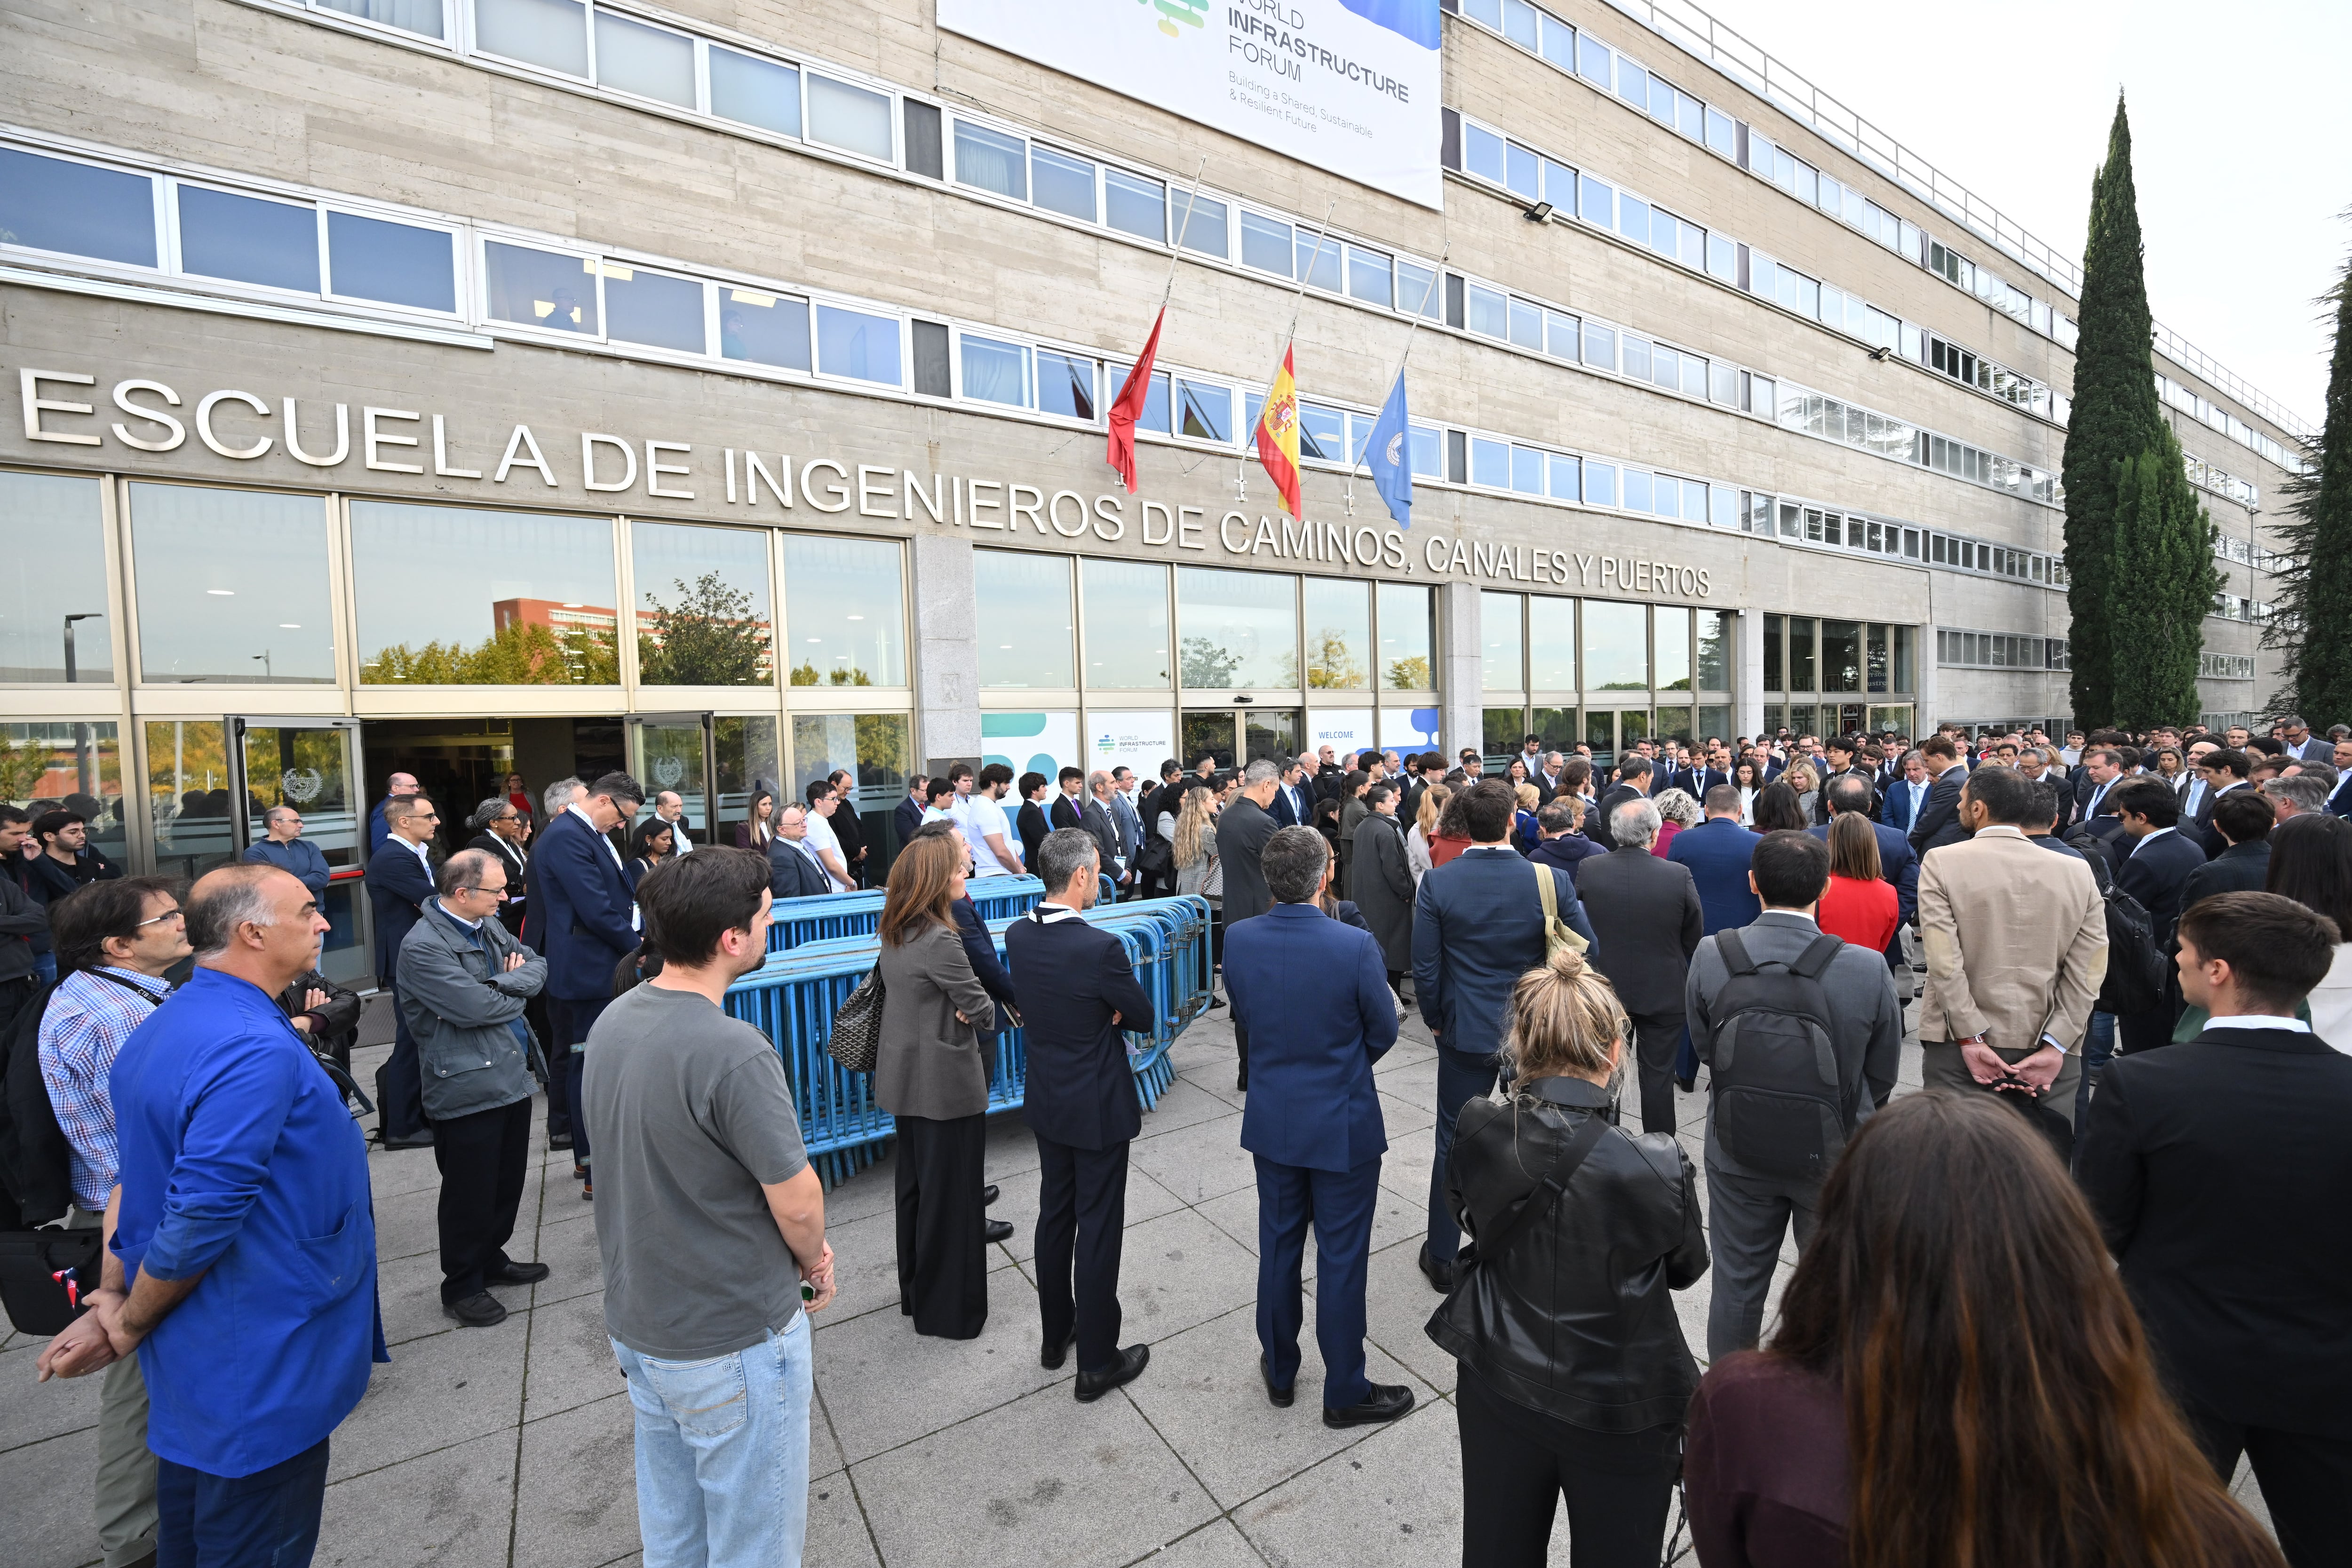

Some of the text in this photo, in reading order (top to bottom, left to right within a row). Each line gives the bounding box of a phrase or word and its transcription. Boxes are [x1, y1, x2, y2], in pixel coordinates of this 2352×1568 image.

[1239, 0, 1304, 30] ORLD
[1228, 7, 1409, 104] INFRASTRUCTURE
[1229, 34, 1301, 83] FORUM
[1229, 70, 1373, 139] Building a Shared, Sustainable
[1229, 88, 1317, 133] & Resilient Future
[19, 367, 1712, 598] ESCUELA DE INGENIEROS DE CAMINOS, CANALES Y PUERTOS
[1319, 731, 1354, 739] WELCOME
